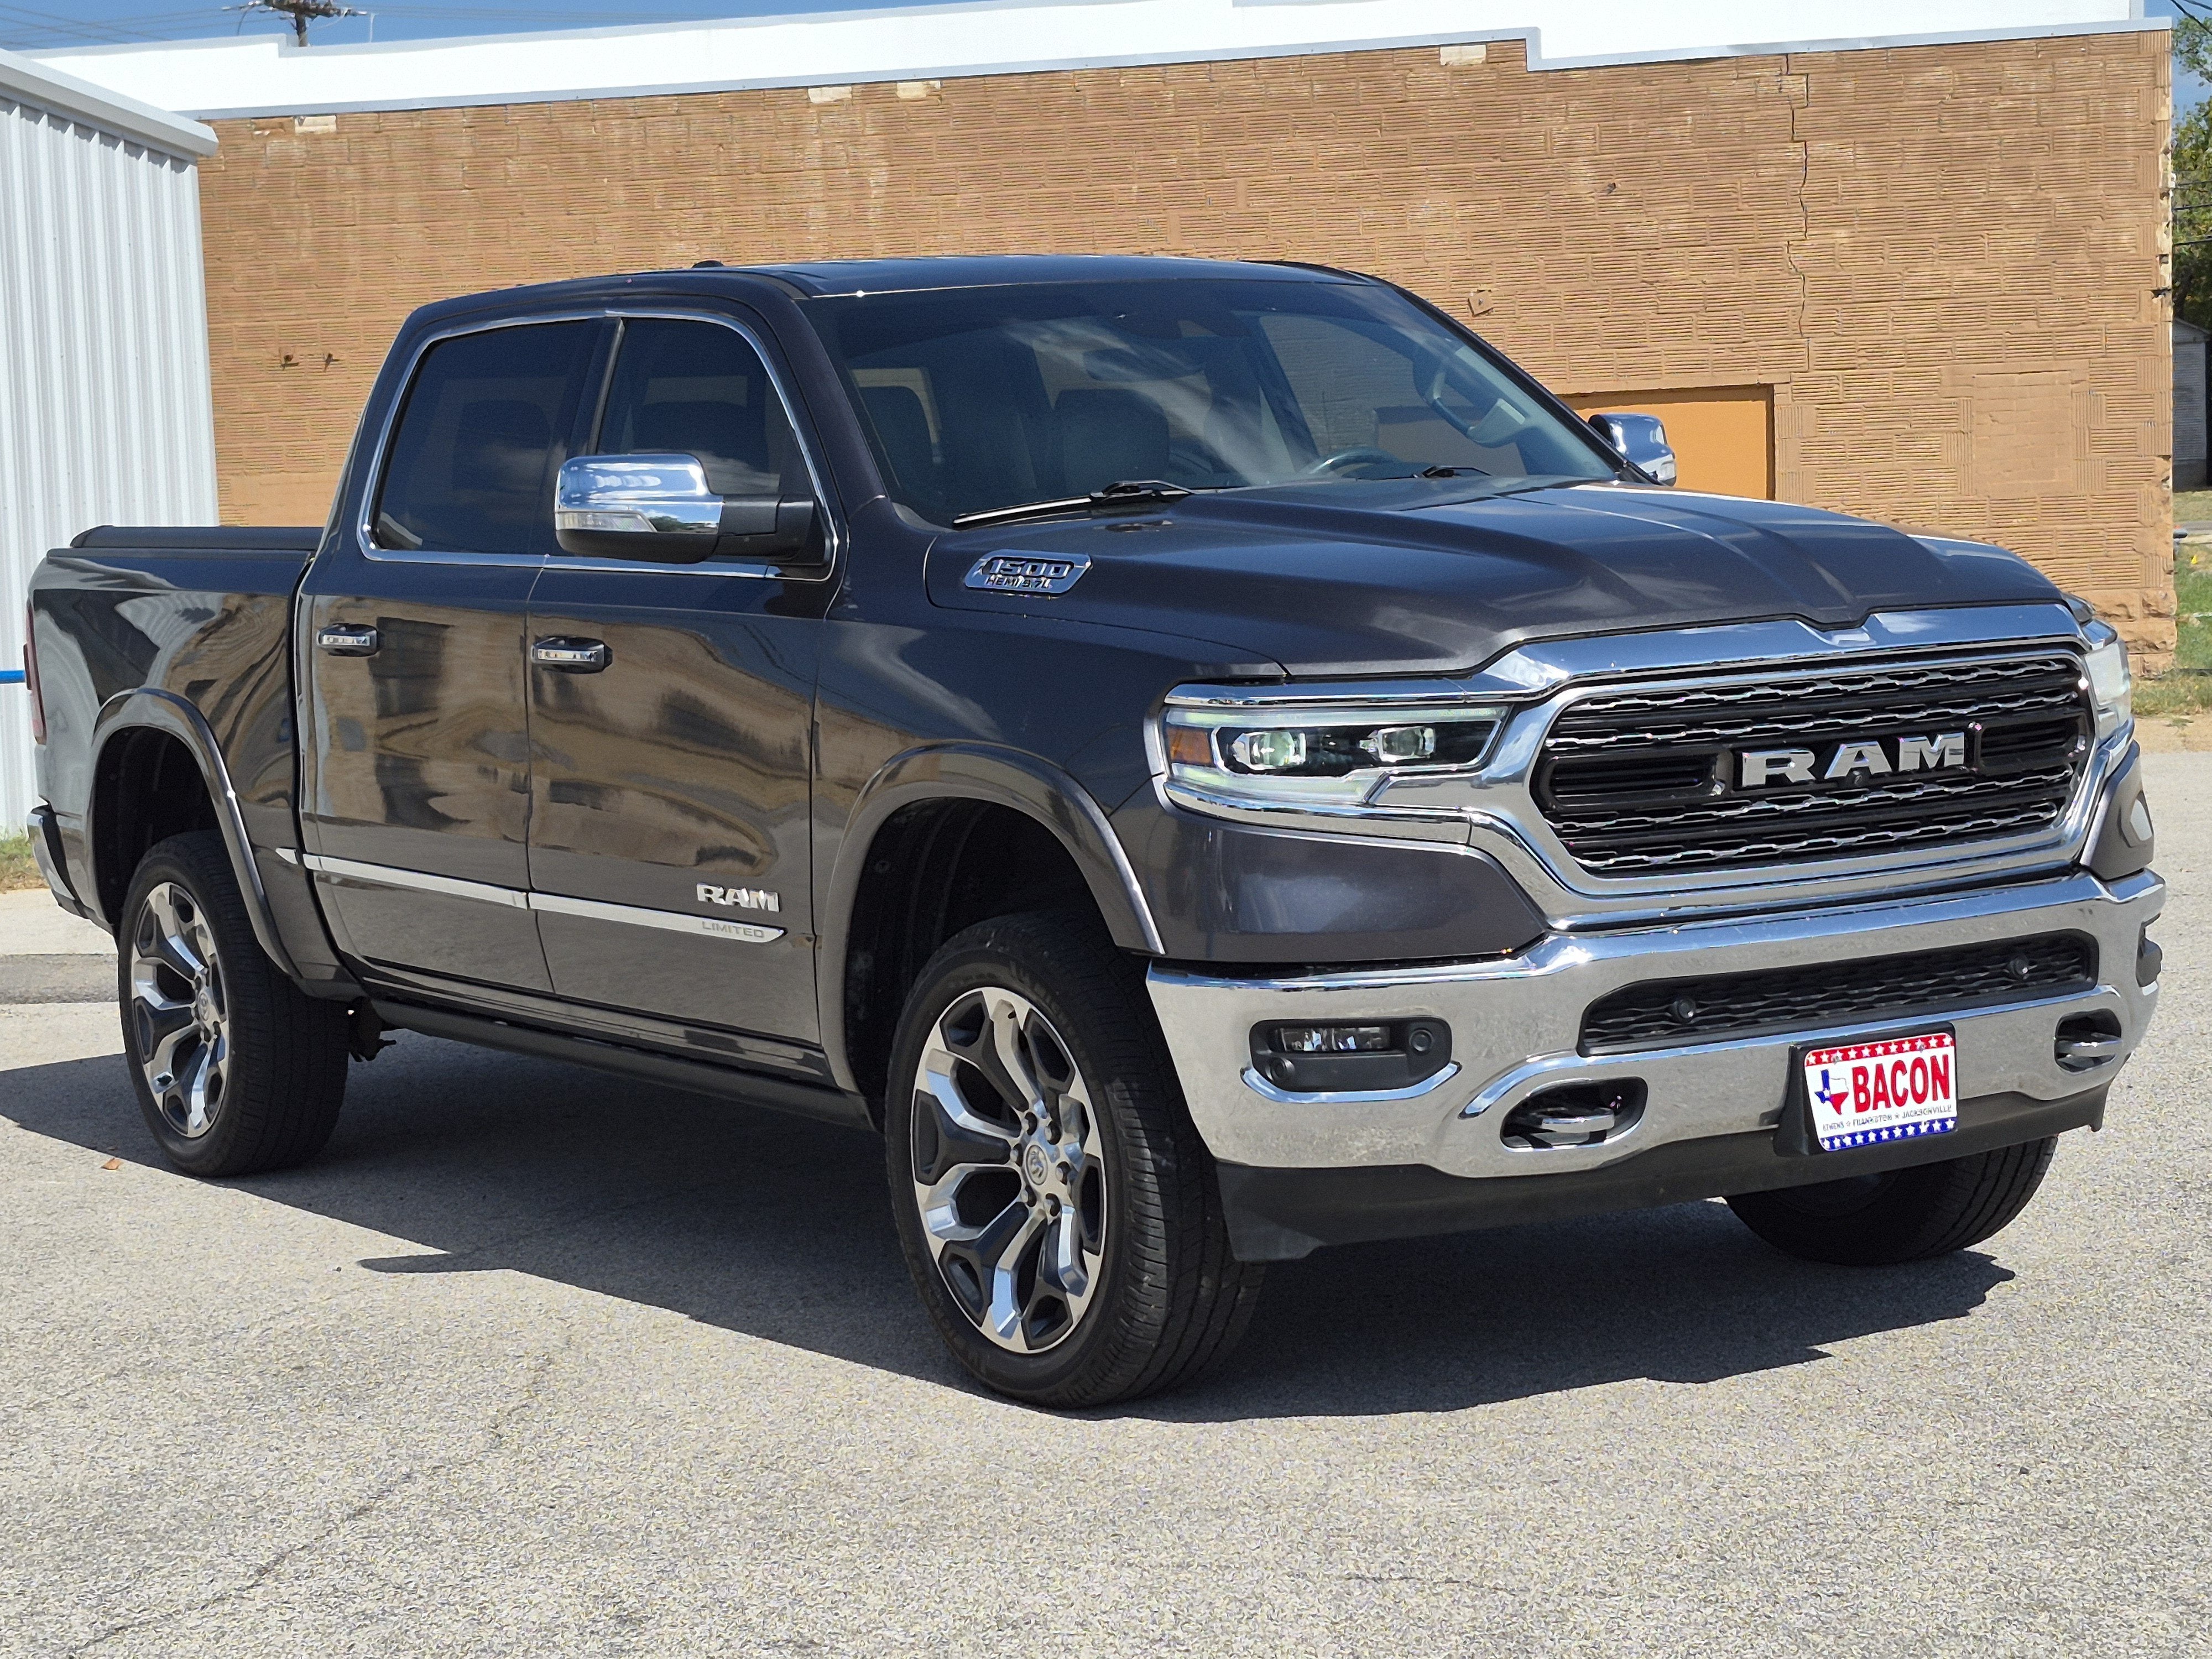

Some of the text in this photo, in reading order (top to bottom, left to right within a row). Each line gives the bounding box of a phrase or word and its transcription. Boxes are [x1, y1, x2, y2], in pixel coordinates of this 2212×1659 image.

[989, 559, 1071, 578] 1500
[984, 574, 1022, 587] HEMI
[1742, 732, 1965, 787] RAM
[696, 883, 780, 912] RAM
[702, 921, 765, 938] LIMITED
[1851, 1053, 1950, 1113] BACON
[1901, 1104, 1952, 1119] JACKSONVILLE
